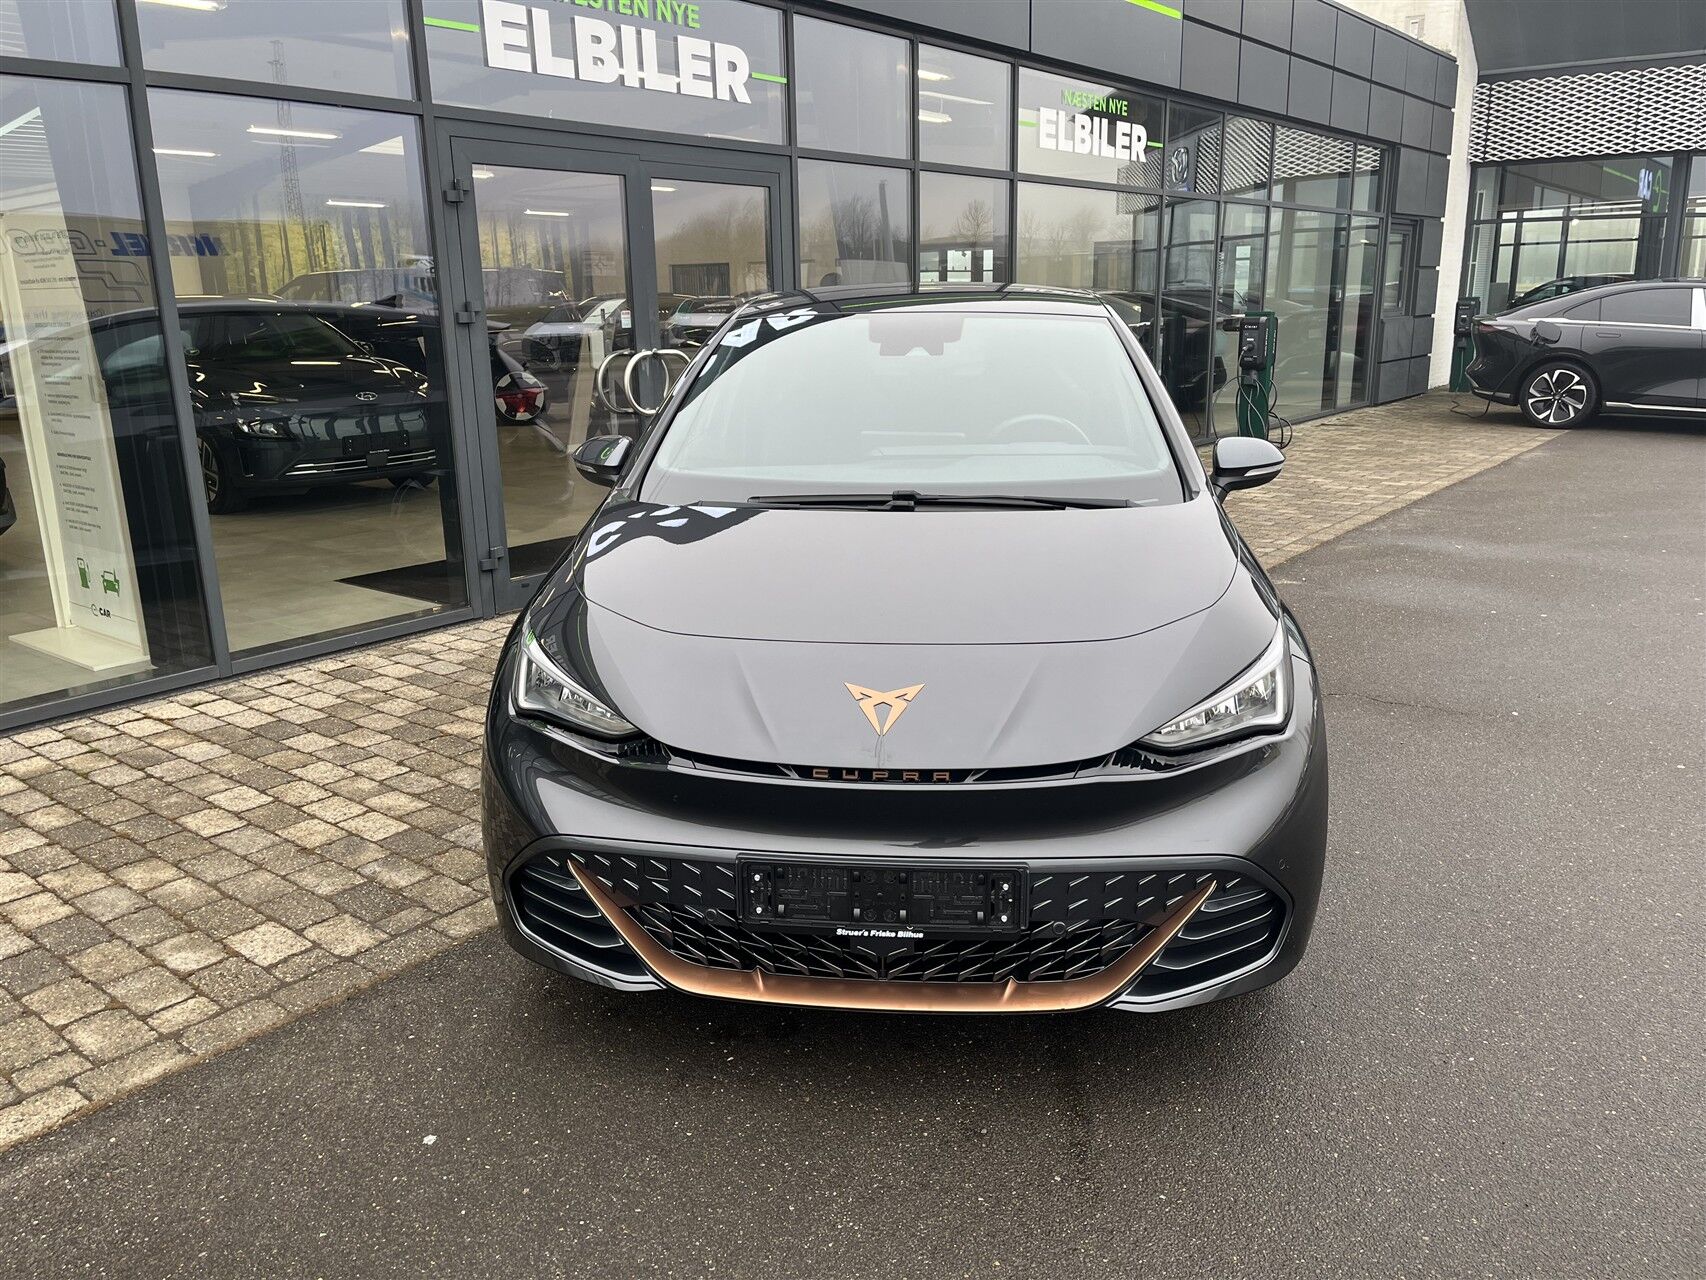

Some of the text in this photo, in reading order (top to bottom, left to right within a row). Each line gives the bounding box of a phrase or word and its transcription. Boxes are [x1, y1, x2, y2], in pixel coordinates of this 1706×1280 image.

[656, 0, 700, 28] NYE
[482, 0, 752, 104] ELBILER
[1109, 98, 1128, 116] NYE
[1040, 106, 1148, 163] ELBILER
[99, 607, 111, 618] CAR
[812, 768, 951, 781] CUPRA
